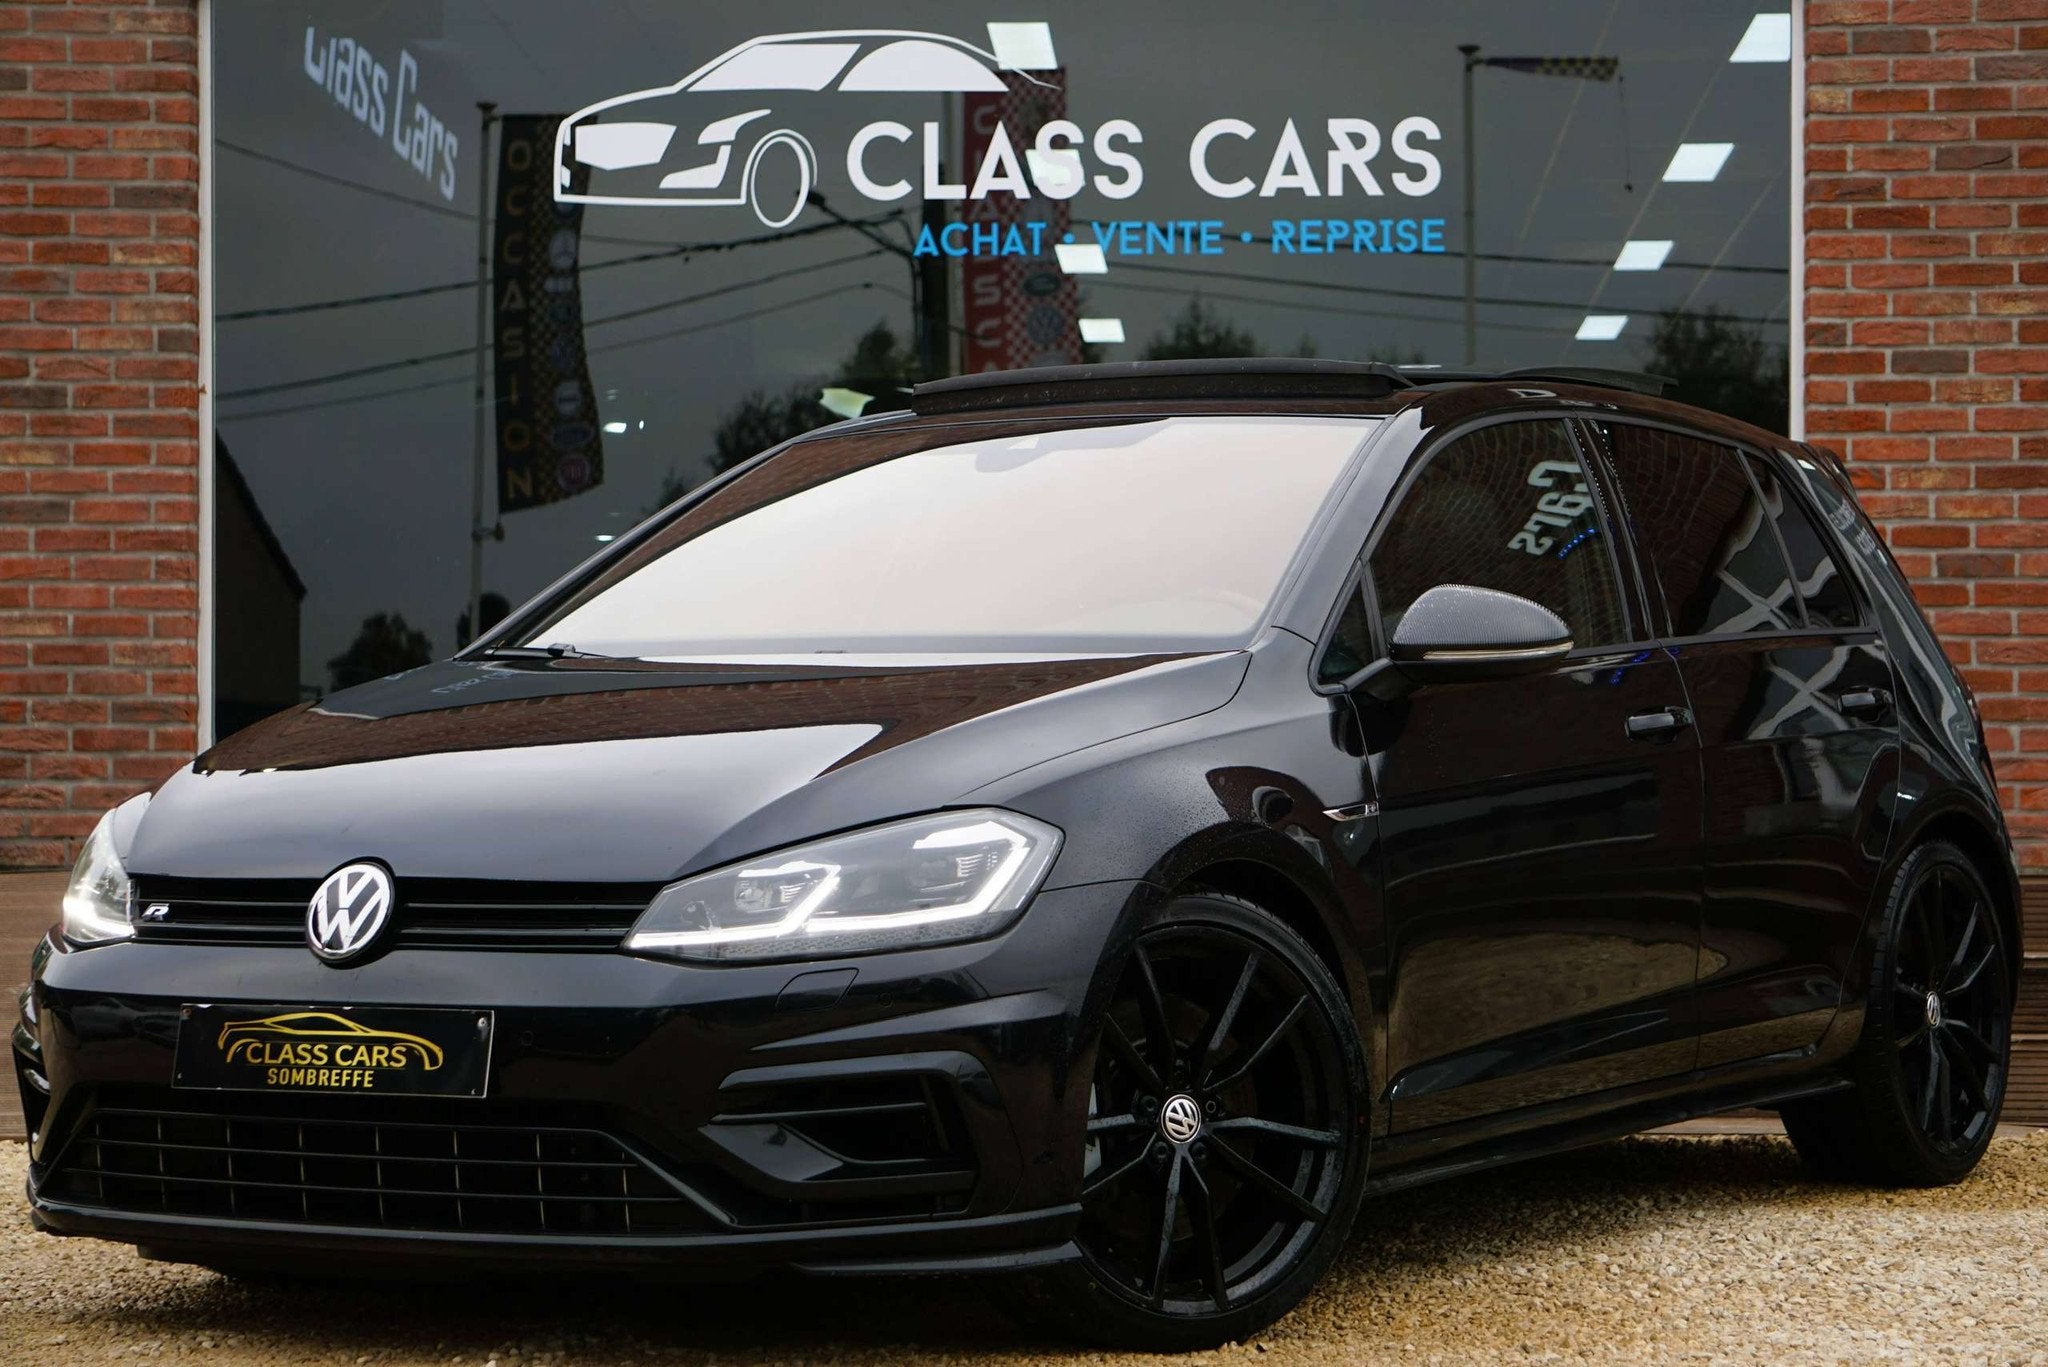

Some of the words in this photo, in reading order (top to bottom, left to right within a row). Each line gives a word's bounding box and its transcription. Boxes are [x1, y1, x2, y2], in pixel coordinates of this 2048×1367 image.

[393, 48, 459, 201] Cars
[847, 118, 1144, 201] CLASS
[1189, 116, 1443, 199] CARS
[912, 220, 1048, 257] ACHAT
[1091, 219, 1225, 256] VENTE
[1270, 217, 1446, 255] REPRISE
[502, 138, 533, 499] OCCASION
[245, 1042, 329, 1067] CLASS
[334, 1045, 408, 1069] CARS
[267, 1067, 375, 1088] SOMBREFFE
